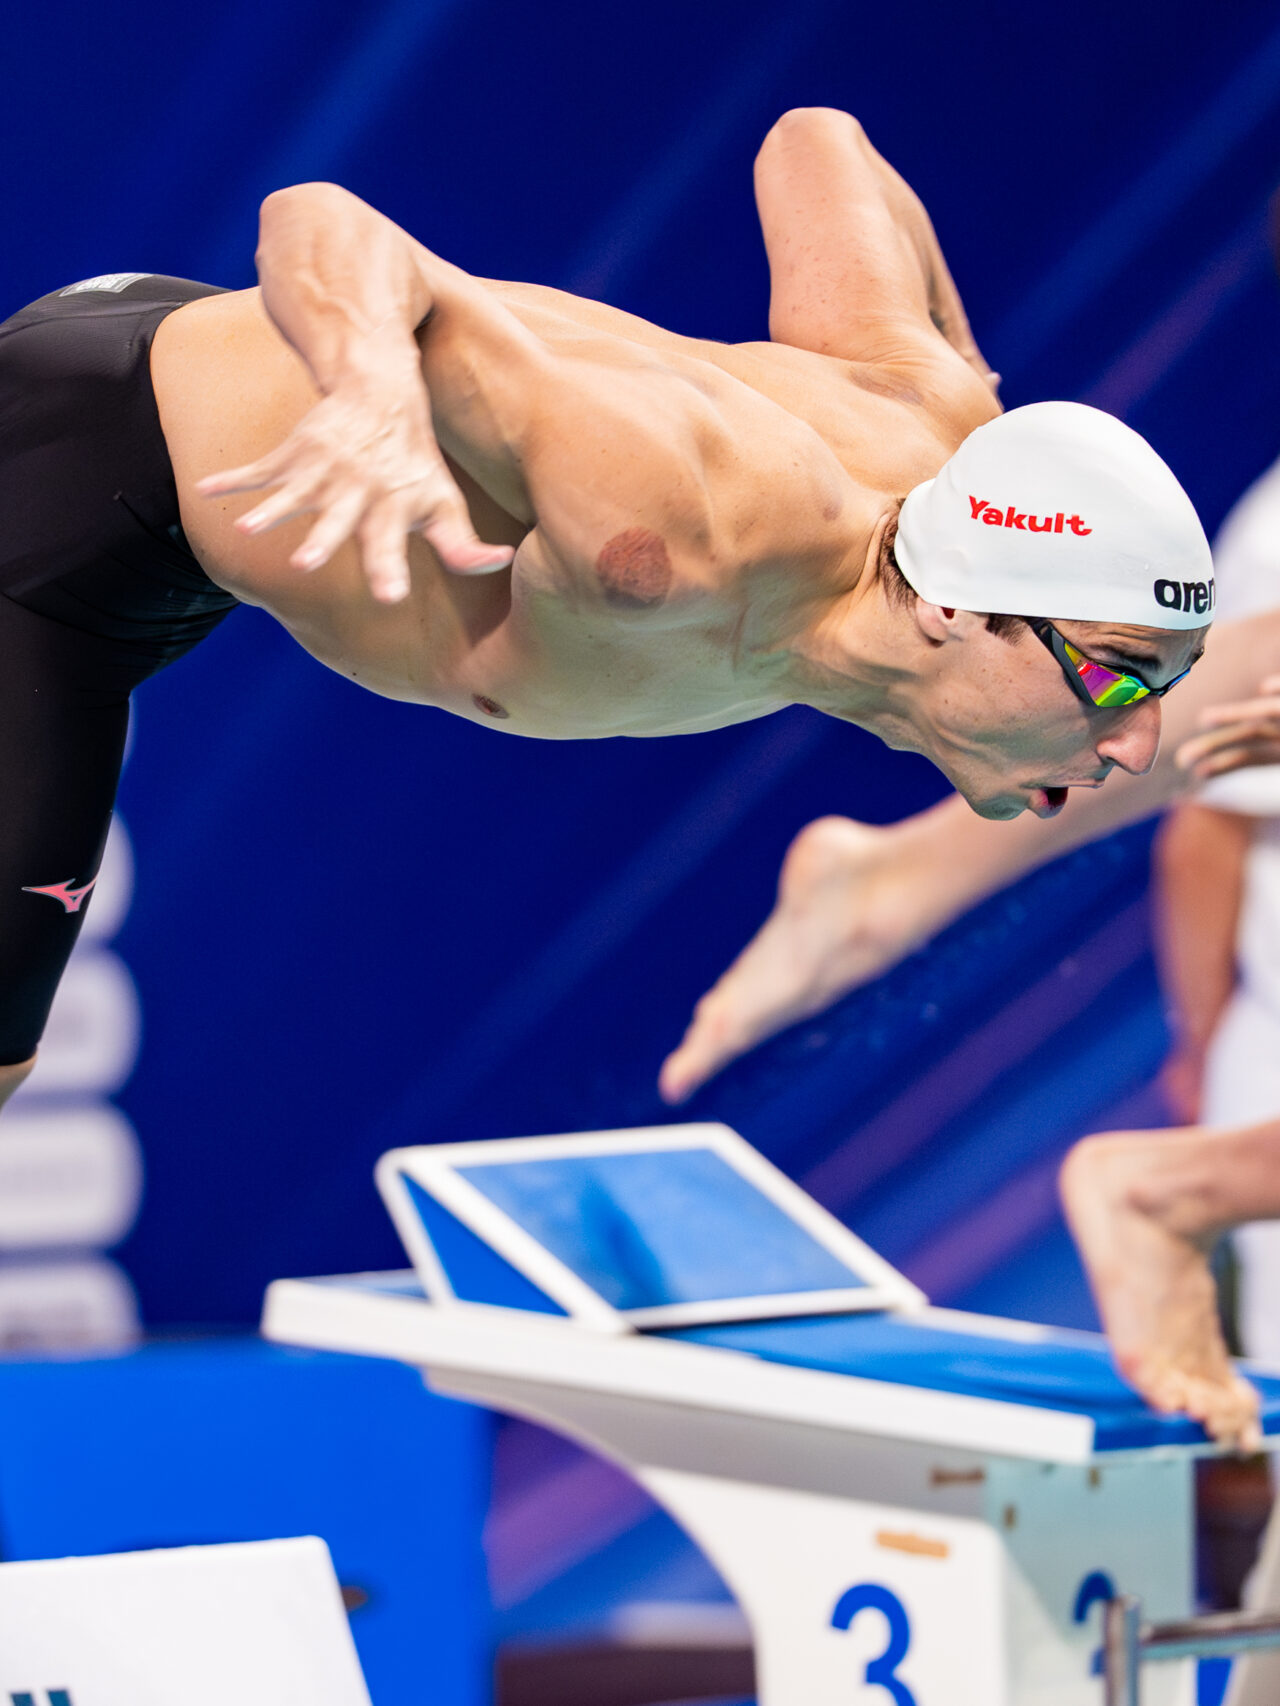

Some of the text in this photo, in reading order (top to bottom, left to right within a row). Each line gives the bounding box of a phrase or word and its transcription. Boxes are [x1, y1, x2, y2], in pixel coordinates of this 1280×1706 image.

[968, 495, 1093, 536] Yakult
[1154, 578, 1216, 614] aren
[830, 1583, 919, 1706] 3
